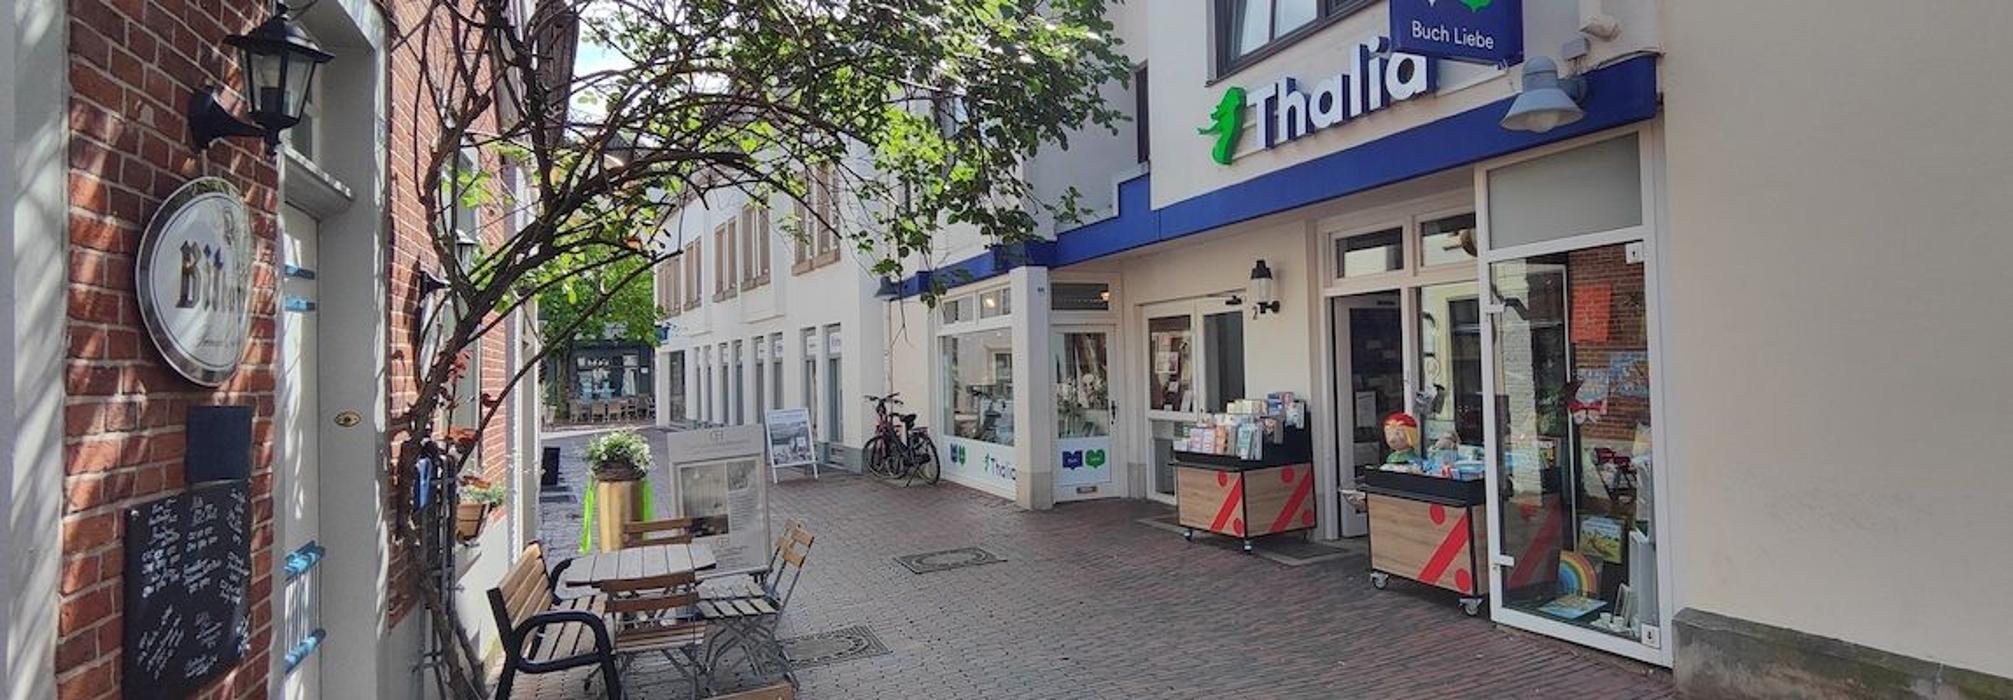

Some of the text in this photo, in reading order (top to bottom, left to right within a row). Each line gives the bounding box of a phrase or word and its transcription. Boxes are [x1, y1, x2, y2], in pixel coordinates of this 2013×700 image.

[1412, 20, 1494, 50] Buch Liebe
[1246, 36, 1429, 149] Thalia
